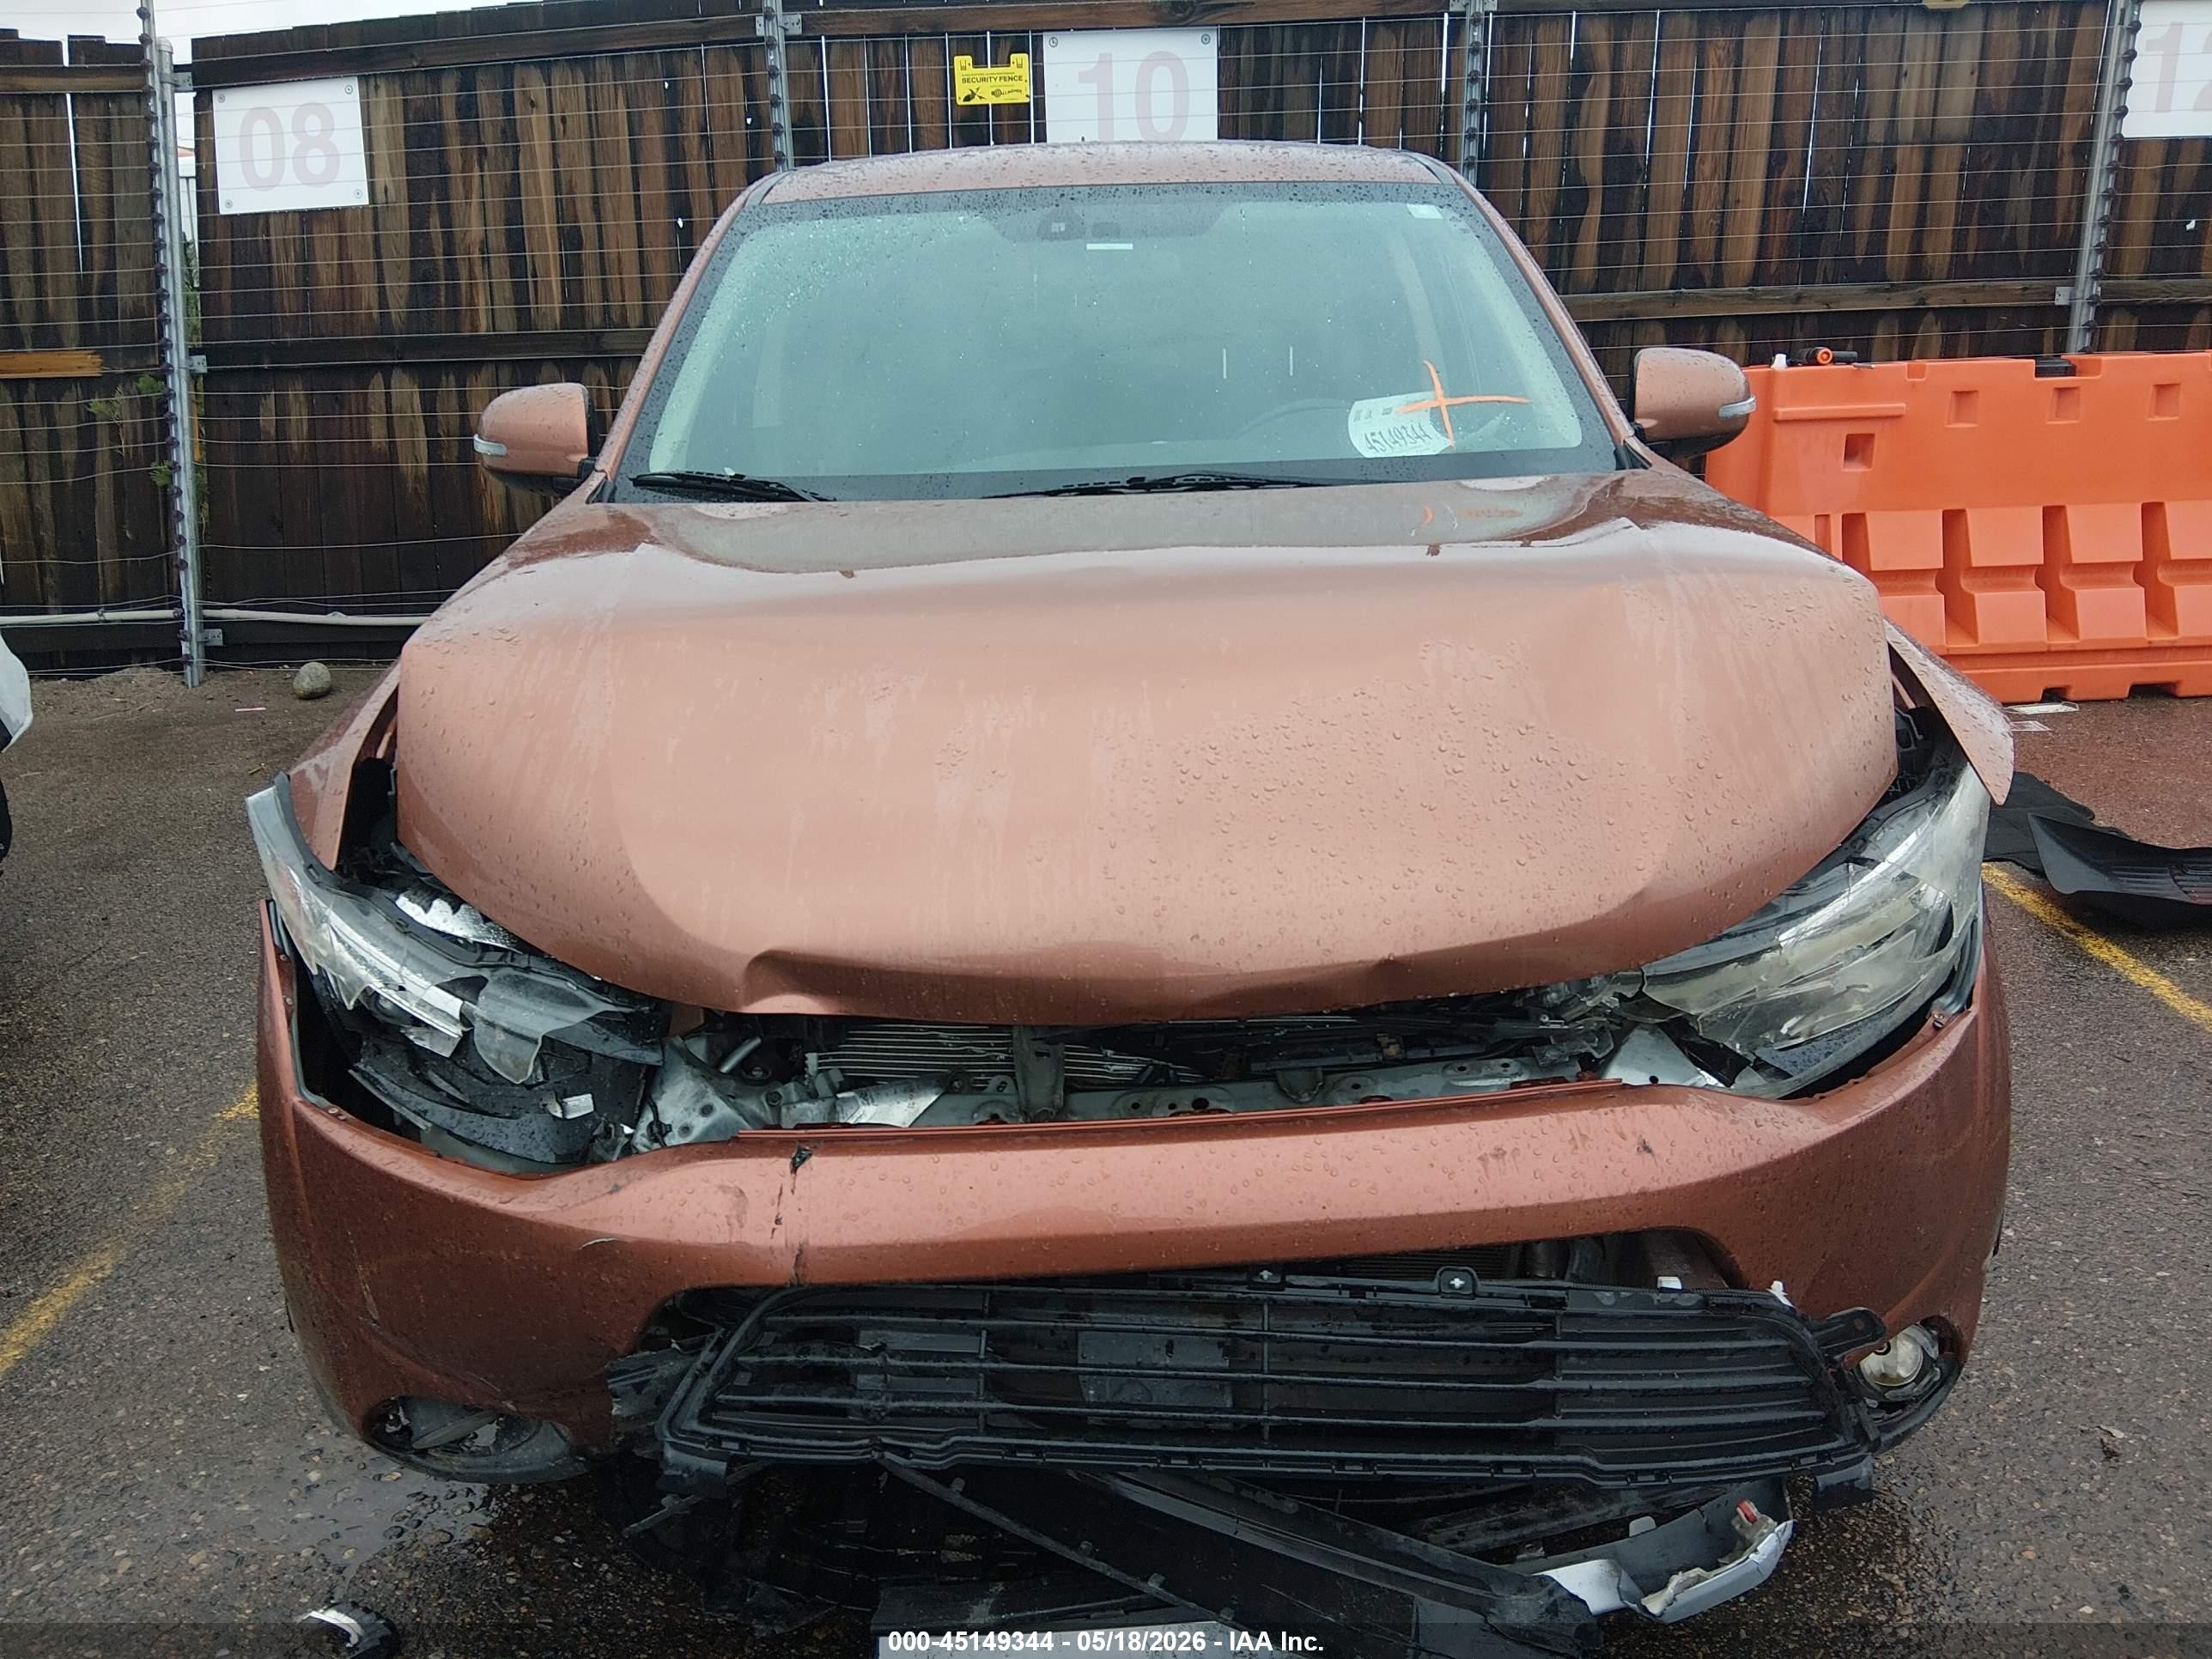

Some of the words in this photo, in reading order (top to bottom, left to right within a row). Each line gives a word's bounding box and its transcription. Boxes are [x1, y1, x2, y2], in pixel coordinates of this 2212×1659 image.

[1079, 51, 1189, 142] 10
[240, 102, 340, 191] 08
[1364, 422, 1432, 453] 45149344
